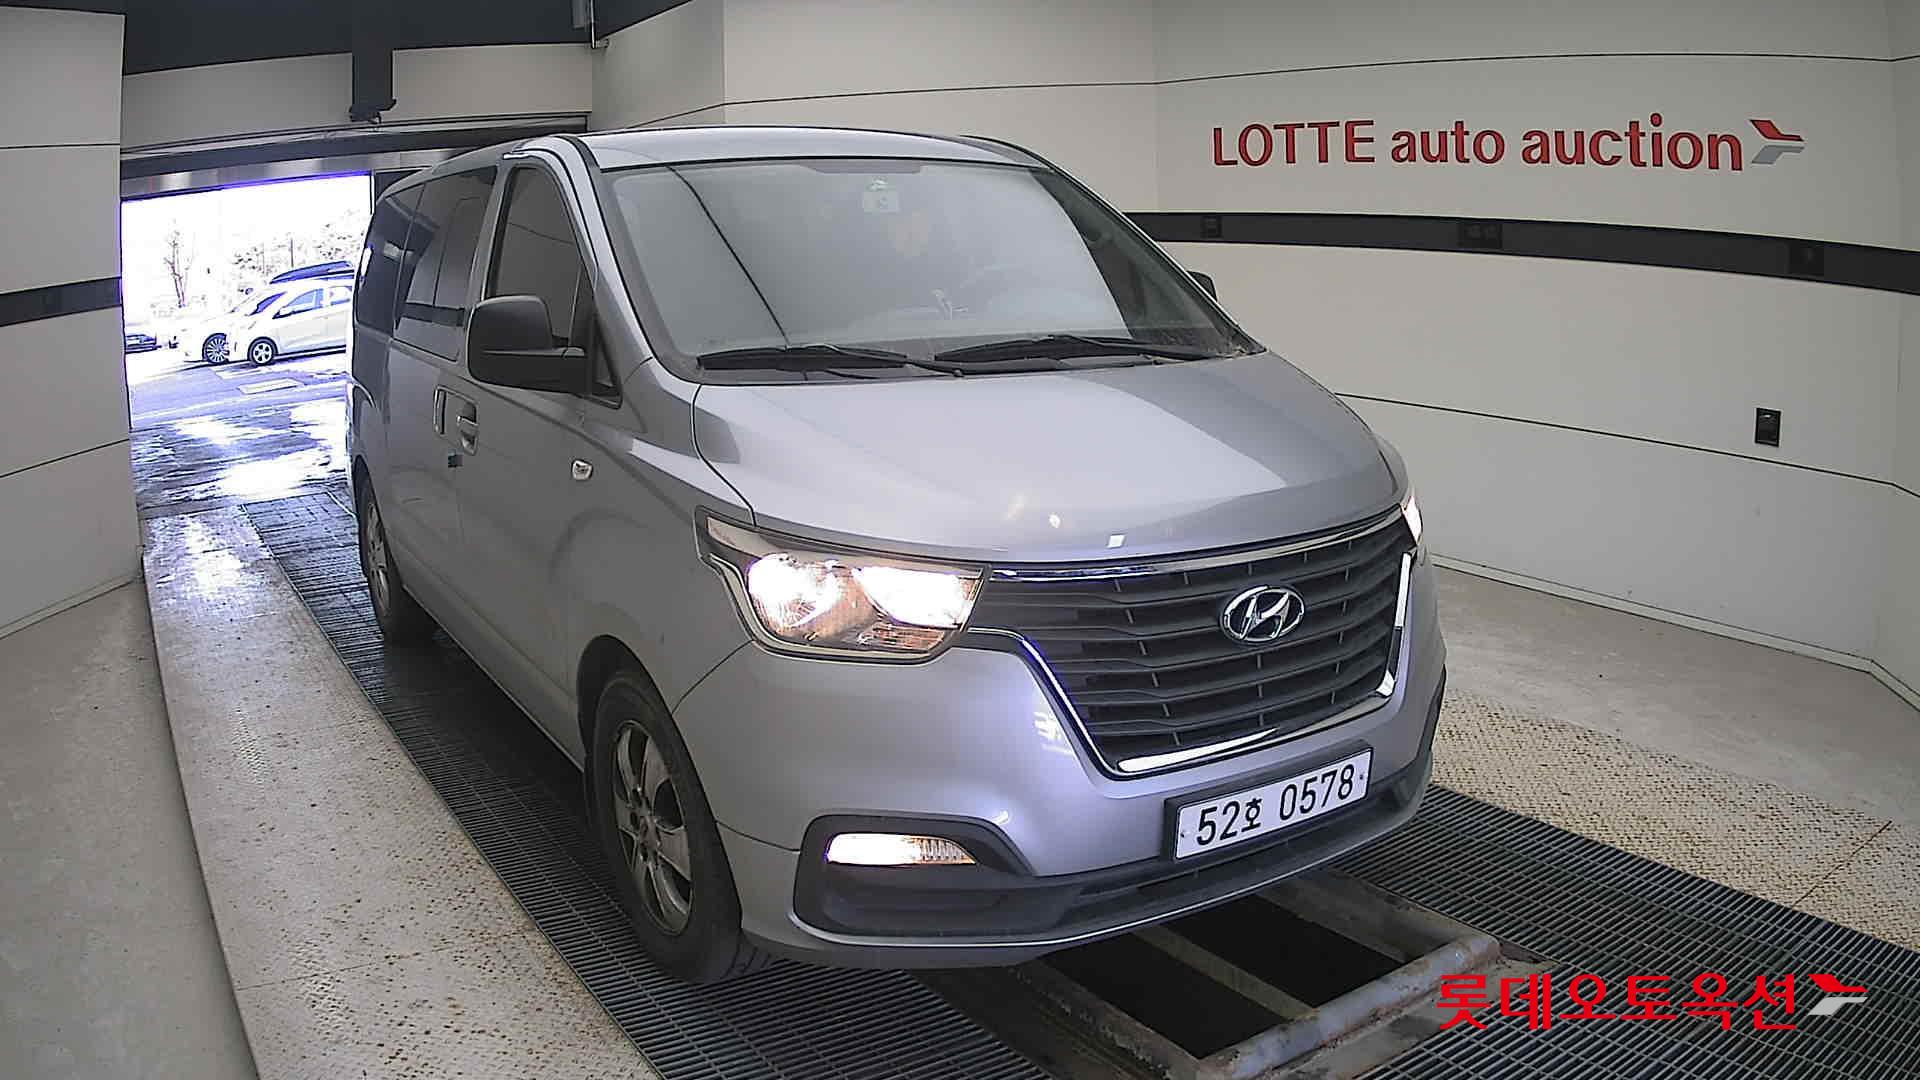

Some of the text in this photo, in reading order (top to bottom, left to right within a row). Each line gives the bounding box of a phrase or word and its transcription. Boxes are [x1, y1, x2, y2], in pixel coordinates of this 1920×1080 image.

[1213, 113, 1744, 171] LOTTE auto auction
[1196, 764, 1355, 846] 52호 0578
